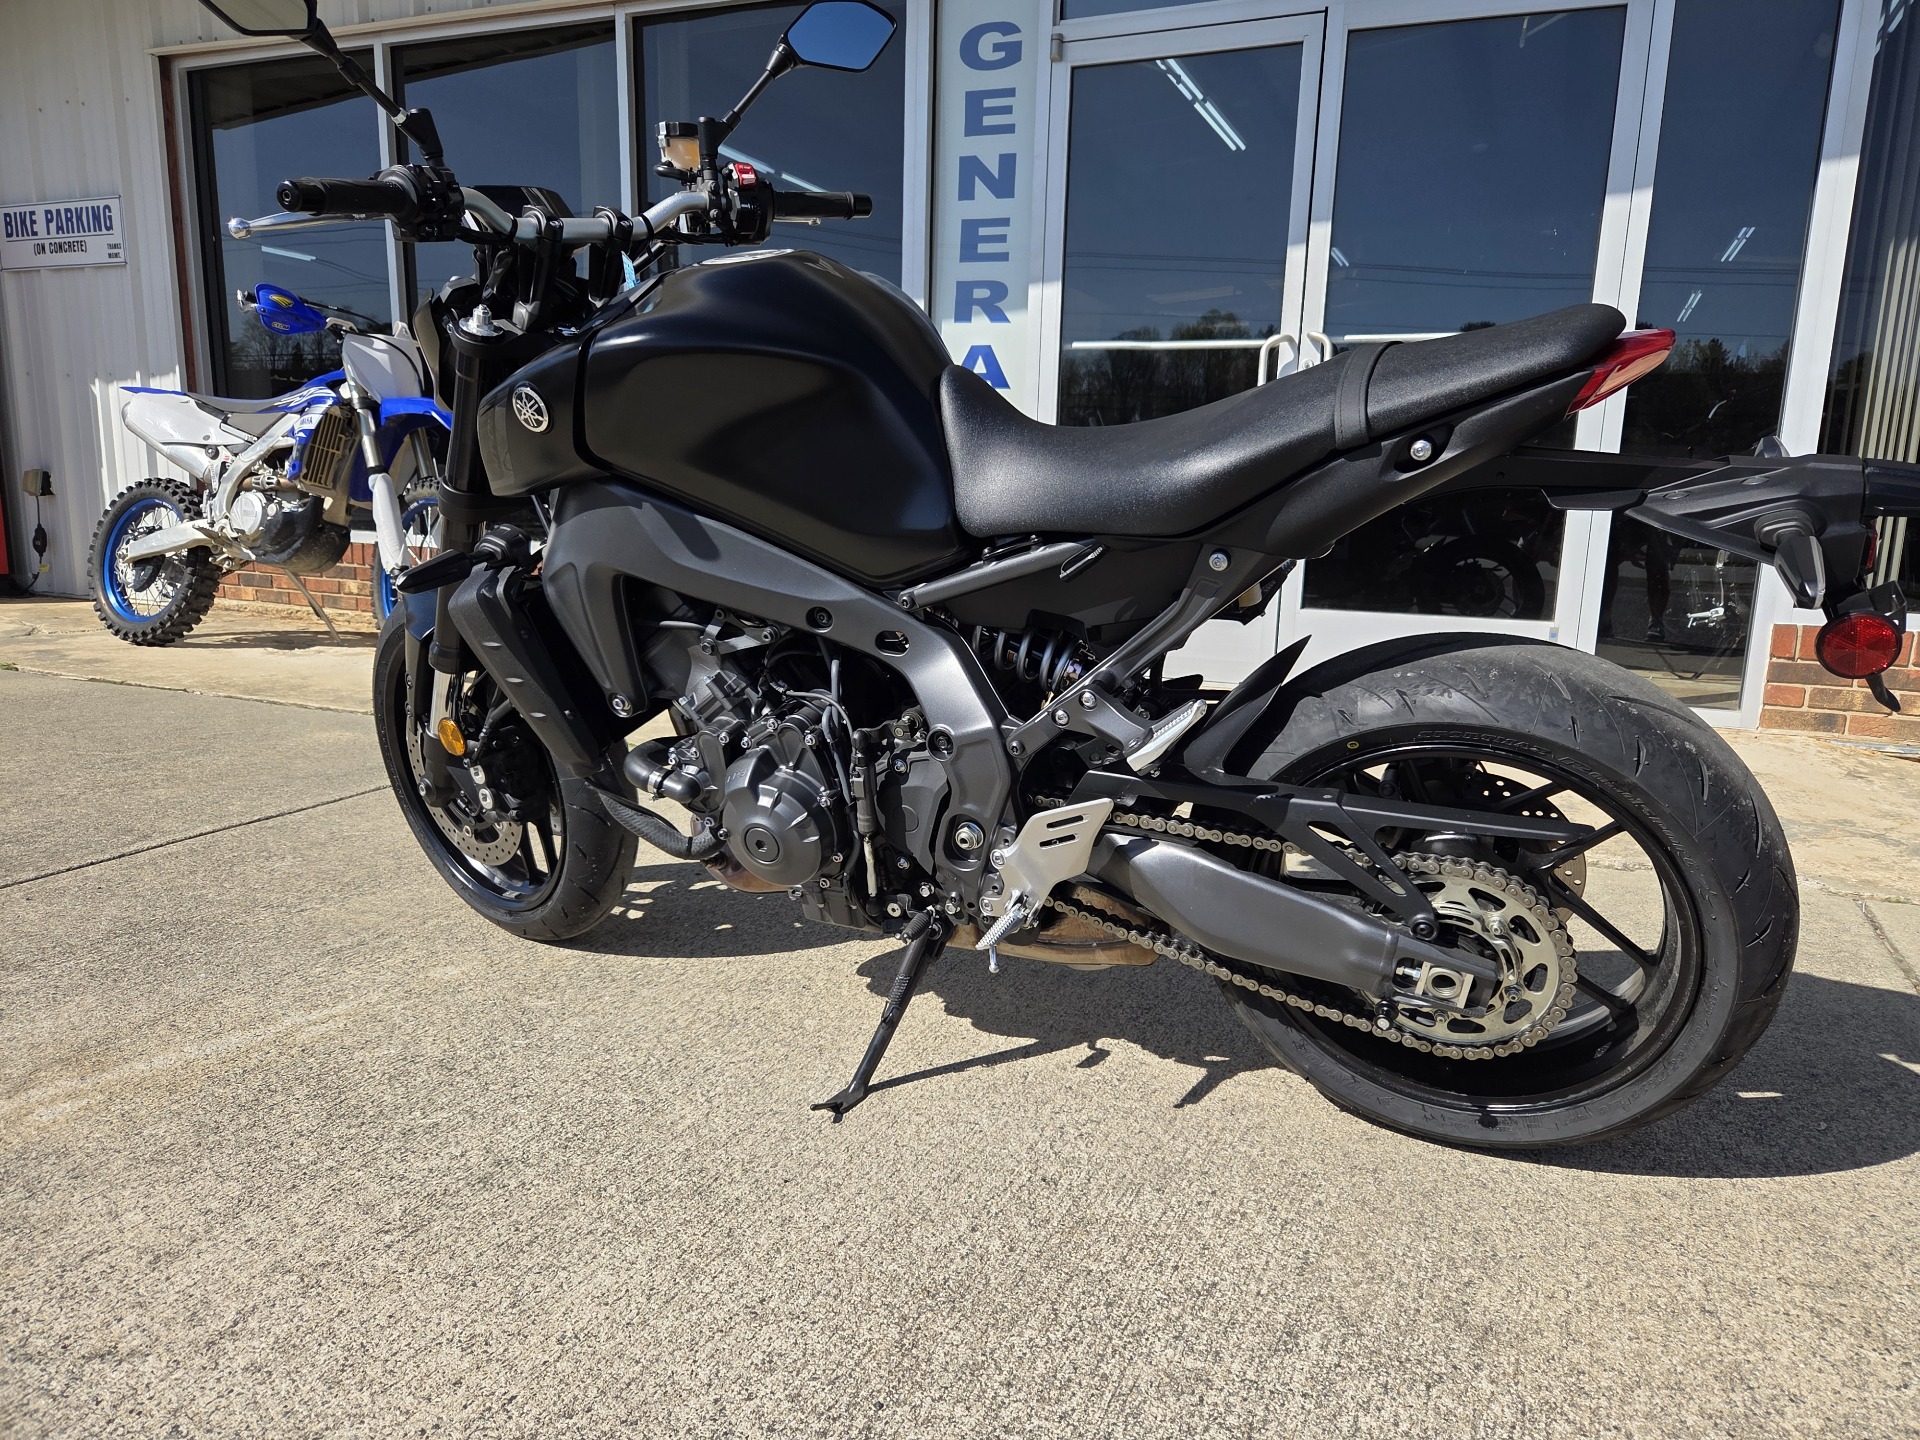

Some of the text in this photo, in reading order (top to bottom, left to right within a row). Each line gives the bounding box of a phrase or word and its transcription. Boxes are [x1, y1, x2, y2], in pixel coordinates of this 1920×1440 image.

[4, 204, 114, 238] BIKE PARKING
[33, 240, 87, 256] (ON CONCRETE)
[106, 242, 122, 250] THANKS
